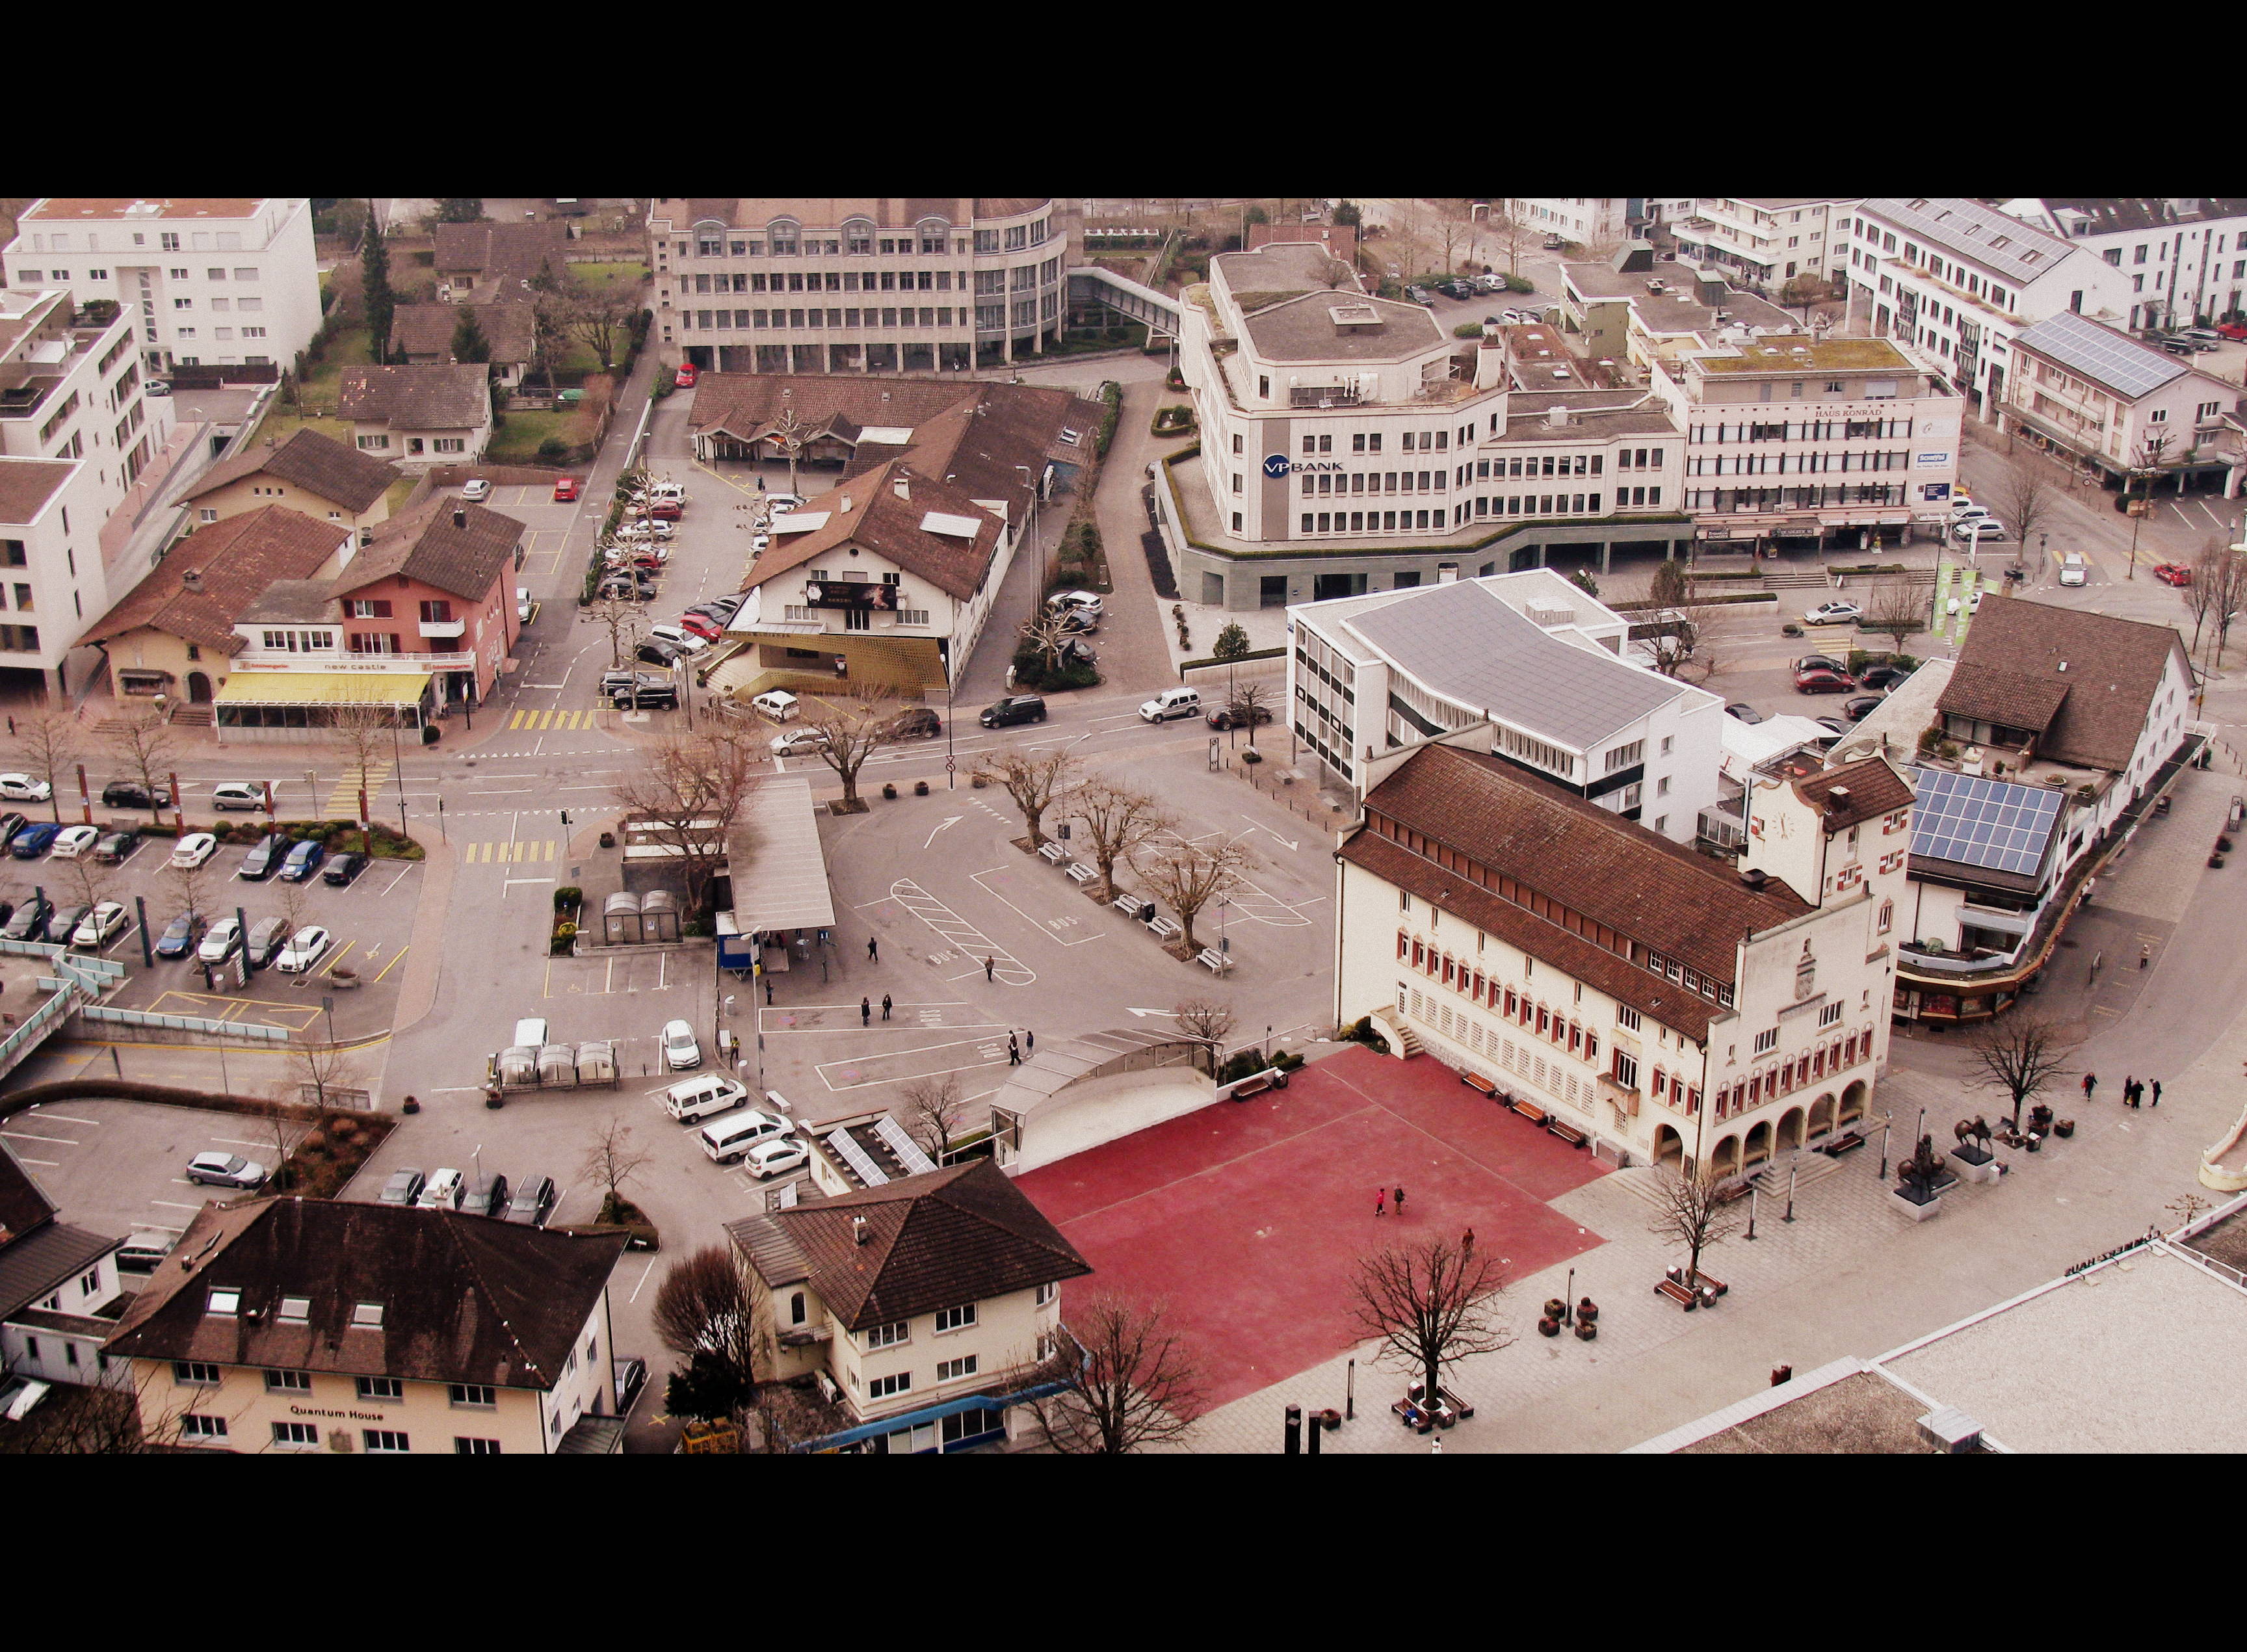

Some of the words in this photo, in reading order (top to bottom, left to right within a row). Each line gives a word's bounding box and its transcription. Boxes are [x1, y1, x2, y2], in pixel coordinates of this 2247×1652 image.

[1291, 462, 1343, 472] BANK
[1048, 915, 1078, 930] BUS
[928, 950, 958, 965] BUS
[919, 1009, 941, 1022] BUS
[977, 1043, 1005, 1058] BUS
[290, 1405, 345, 1418] Quantum
[349, 1410, 384, 1421] House
